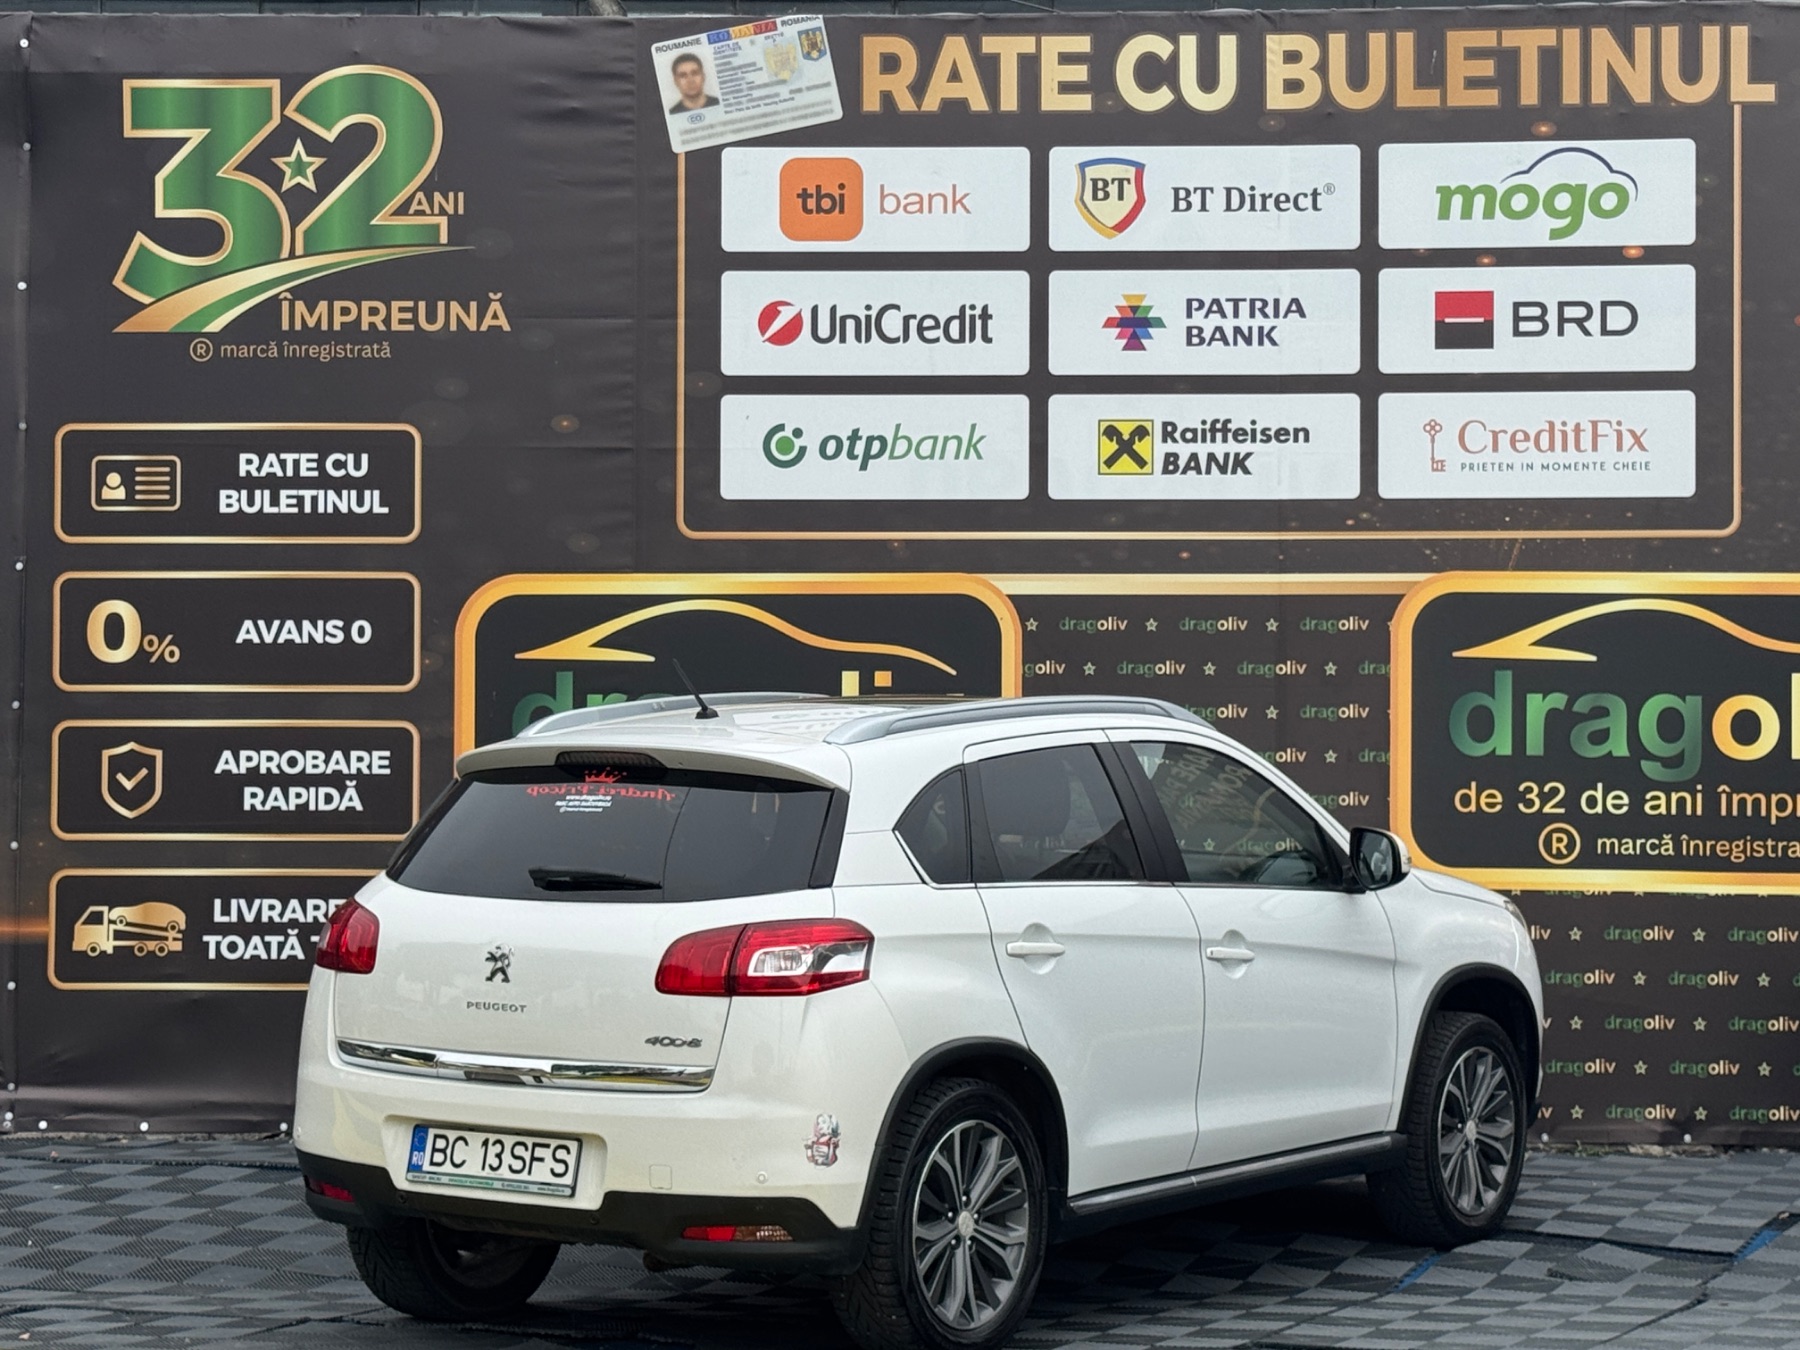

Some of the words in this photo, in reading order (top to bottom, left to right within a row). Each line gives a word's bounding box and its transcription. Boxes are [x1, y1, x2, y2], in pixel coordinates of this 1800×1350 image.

[655, 36, 702, 54] ROUMANIE
[862, 35, 1093, 112] RATE
[1115, 34, 1237, 112] CU
[1265, 25, 1776, 110] BULETINUL
[112, 64, 447, 305] 32
[1090, 177, 1131, 202] BT
[408, 191, 465, 216] ANI
[796, 183, 846, 215] tbi
[879, 184, 972, 214] bank
[1171, 187, 1214, 212] BT
[1435, 182, 1630, 241] mogo
[278, 291, 511, 333] ÎMPREUNĂ
[1185, 297, 1306, 320] PATRIA
[1512, 300, 1639, 338] BRD
[810, 303, 993, 345] UniCredit
[1185, 325, 1279, 348] BANK
[220, 341, 278, 359] marcă
[282, 340, 392, 362] înregistrată
[1161, 419, 1309, 445] Raiffeisen
[1458, 419, 1649, 455] CreditFix
[818, 423, 987, 471] otpbank
[238, 453, 319, 478] RATE
[325, 453, 369, 478] CU
[1161, 452, 1253, 476] BANK
[1460, 462, 1515, 473] PRIETEN
[1521, 461, 1534, 472] IN
[1540, 461, 1605, 472] MOMENTE
[1613, 461, 1652, 472] CHEIE
[218, 489, 389, 514] BULETINUL
[86, 600, 181, 663] 0%
[235, 619, 345, 645] AVANS
[351, 619, 372, 645] 0
[1059, 617, 1128, 633] dragoliv
[1179, 617, 1248, 633] dragoliv
[1300, 617, 1369, 633] dragoliv
[1022, 660, 1066, 677] goliv
[1117, 660, 1186, 677] dragoliv
[1237, 660, 1307, 677] dragoliv
[1186, 704, 1248, 721] ragoliv
[1300, 704, 1369, 721] dragoliv
[214, 750, 391, 775] APROBARE
[243, 780, 364, 812] RAPIDĂ
[1454, 781, 1503, 813] de
[1517, 782, 1566, 814] 32
[1580, 783, 1630, 815] de
[1643, 785, 1703, 816] ani
[1597, 835, 1674, 856] marcă
[203, 930, 305, 960] TOATĂ
[1604, 925, 1674, 943] dragoliv
[1728, 926, 1799, 945] dragoliv
[1545, 969, 1615, 988] dragoliv
[1668, 970, 1739, 988] dragoliv
[466, 1001, 527, 1013] PEUGEOT
[1604, 1015, 1675, 1033] dragoliv
[1728, 1016, 1800, 1035] dragoliv
[645, 1036, 702, 1048] 4008
[1546, 1059, 1616, 1077] dragoliv
[1669, 1060, 1740, 1078] dragoliv
[1605, 1104, 1676, 1122] dragoliv
[1729, 1105, 1800, 1123] dragoliv
[412, 1151, 424, 1165] RO
[429, 1133, 469, 1168] BC
